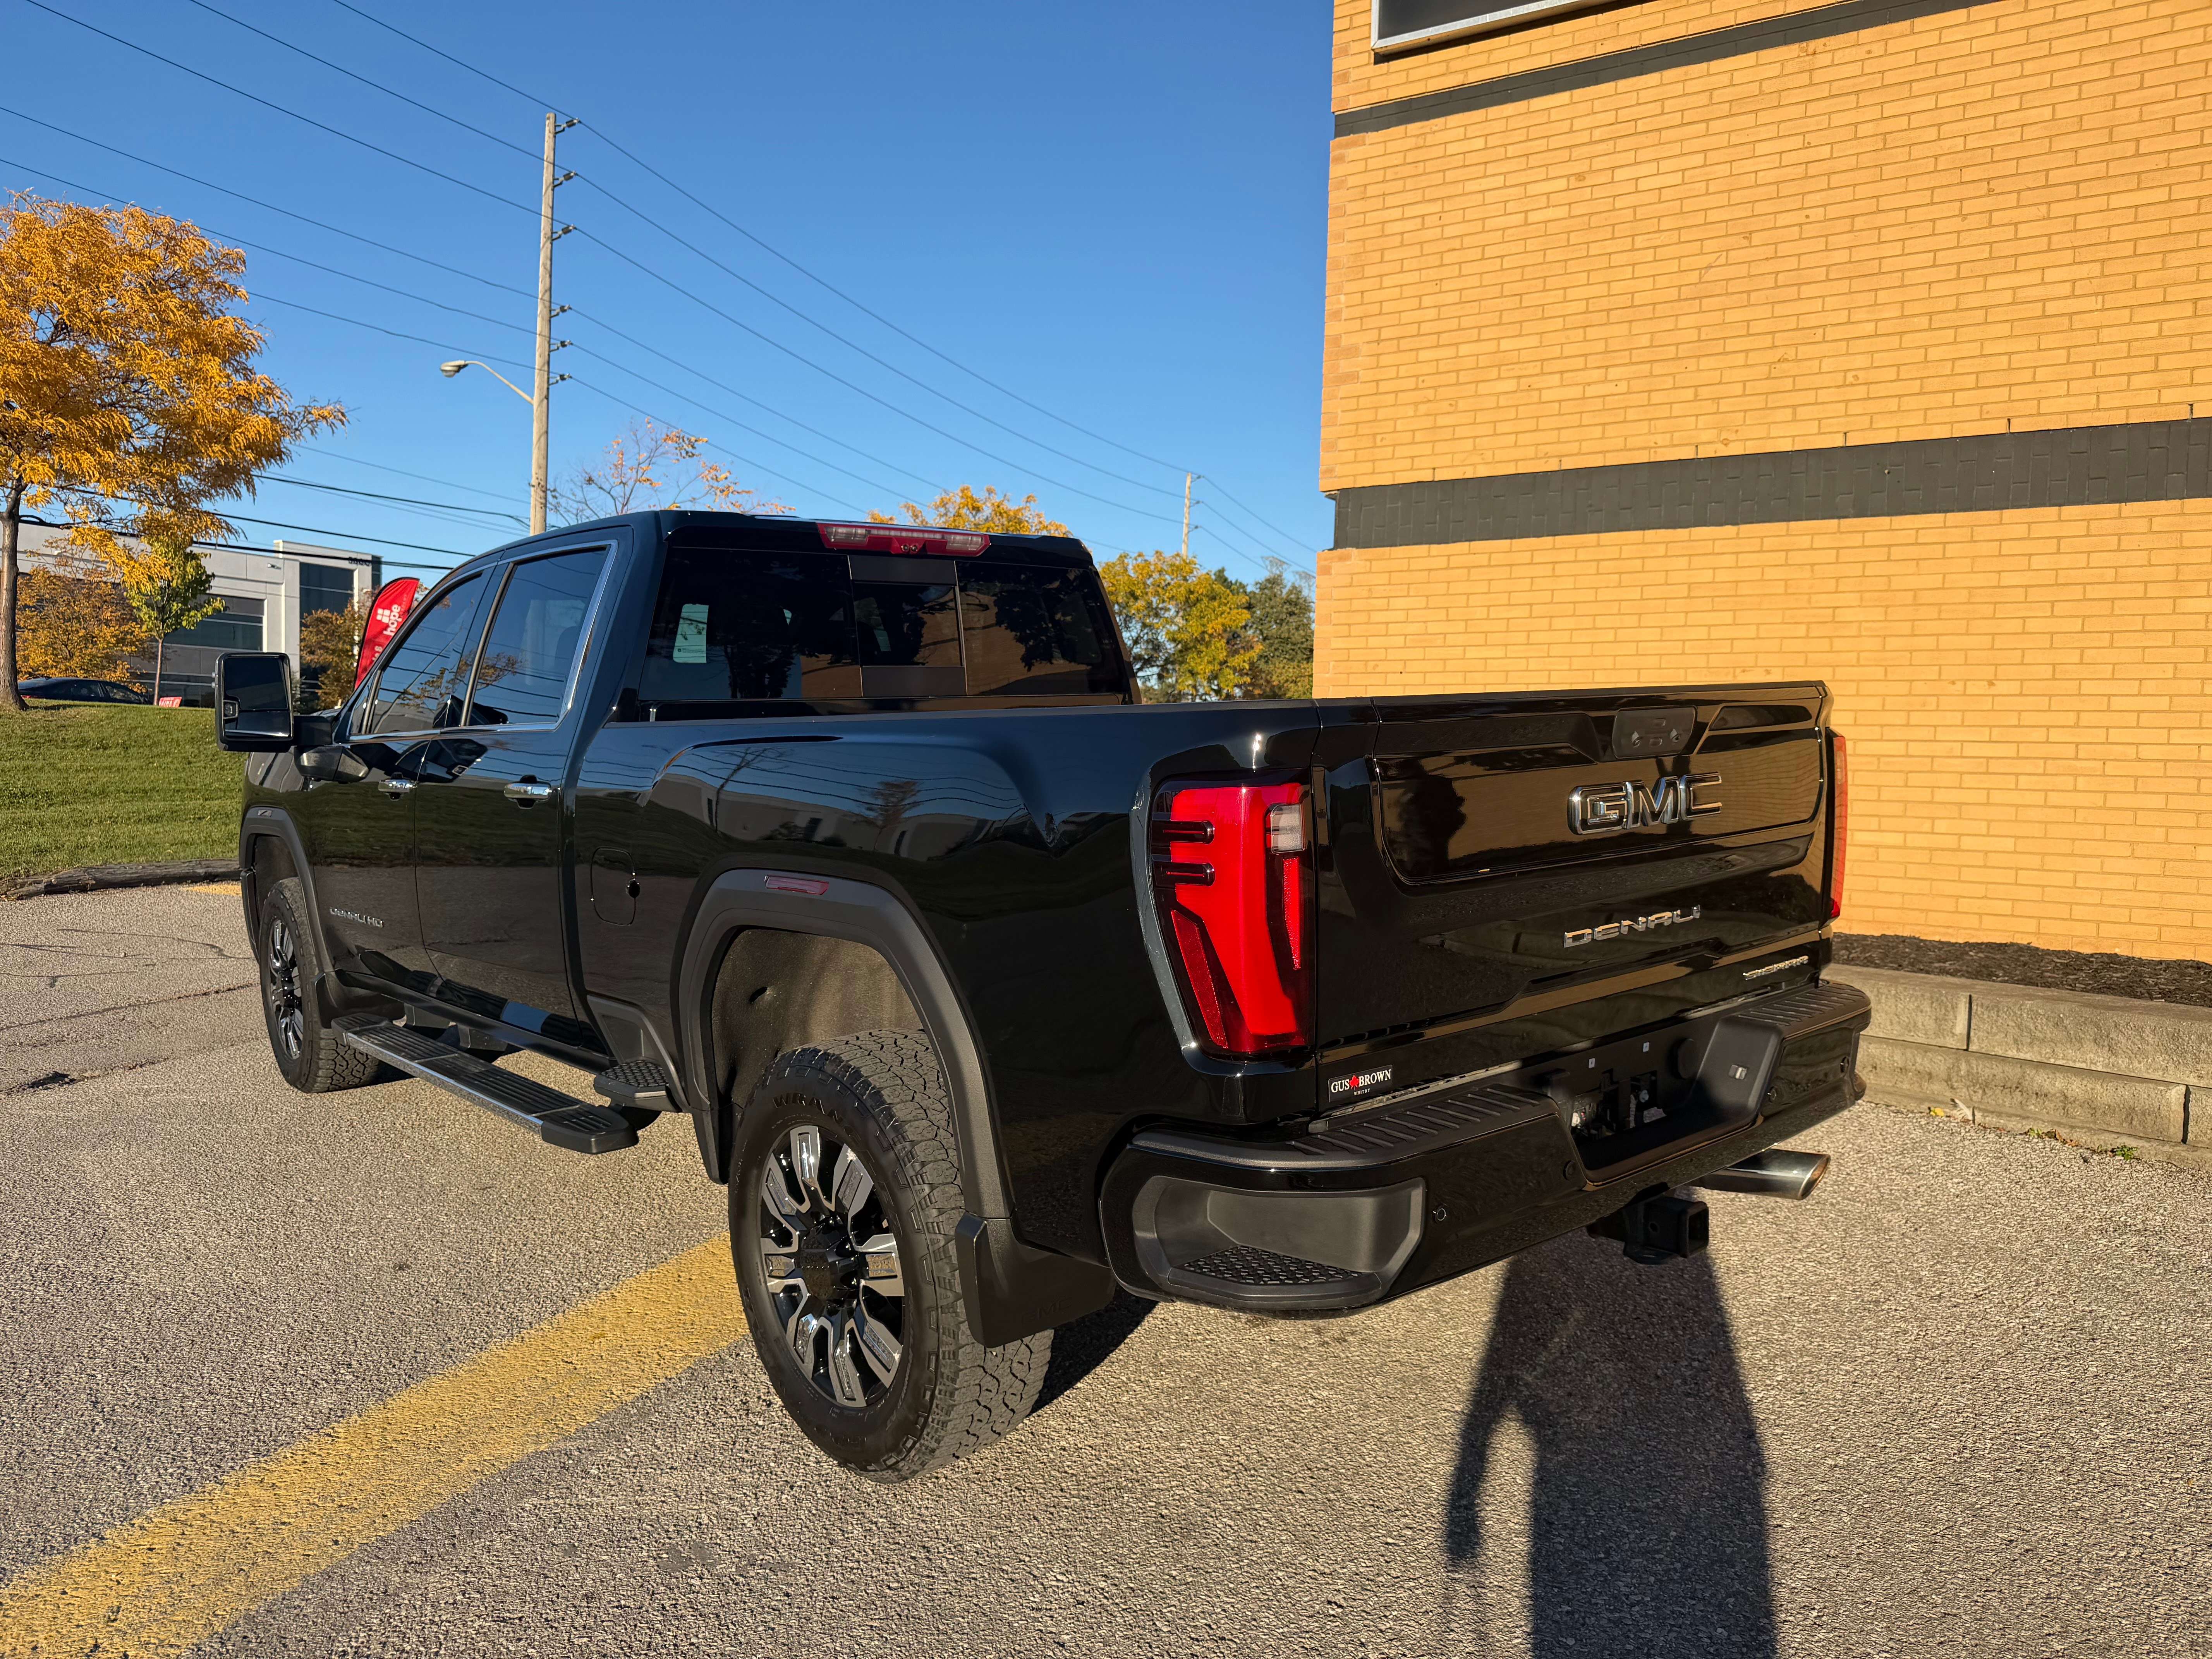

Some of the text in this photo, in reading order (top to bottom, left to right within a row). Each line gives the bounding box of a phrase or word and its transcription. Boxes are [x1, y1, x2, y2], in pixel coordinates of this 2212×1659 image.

[383, 604, 401, 636] hope
[1567, 771, 1722, 835] GMC
[330, 907, 383, 928] DENALI HD
[1563, 905, 1701, 948] DENALI
[1331, 1069, 1391, 1093] GUS BROWN
[1021, 1297, 1072, 1325] GMC
